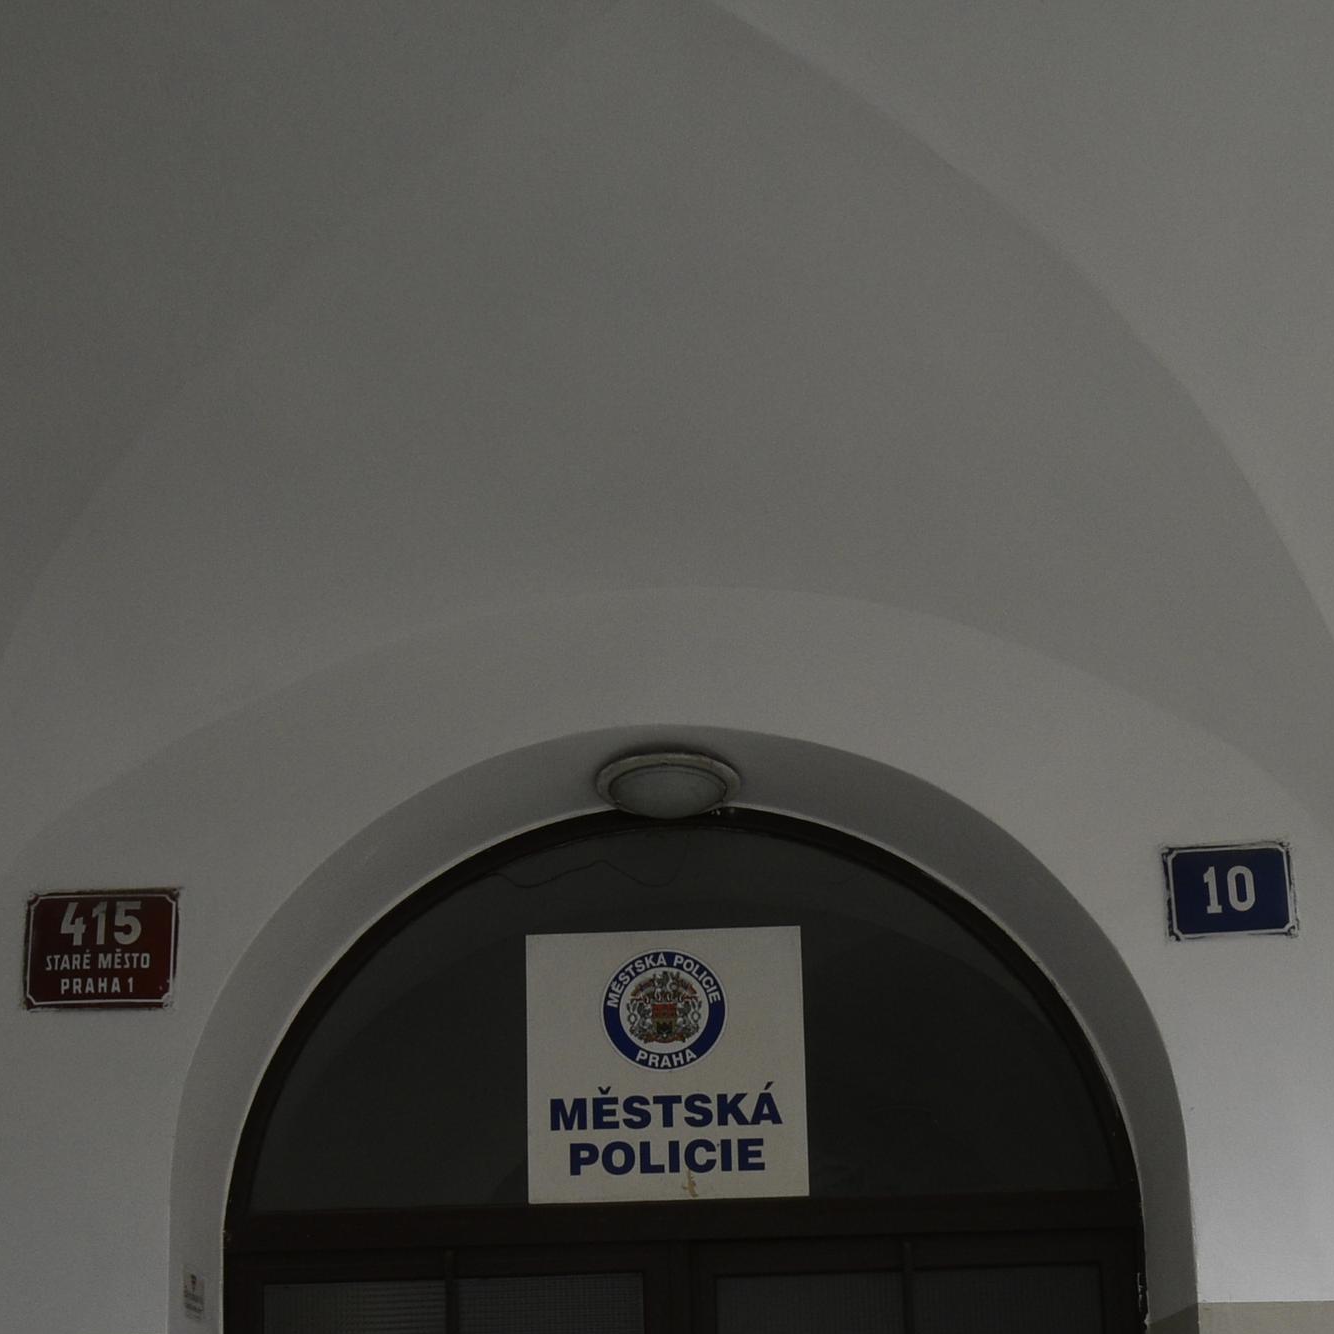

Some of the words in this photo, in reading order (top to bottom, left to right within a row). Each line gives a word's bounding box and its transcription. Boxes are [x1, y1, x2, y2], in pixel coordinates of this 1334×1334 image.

[1203, 865, 1256, 914] 10
[60, 901, 142, 946] 415
[45, 949, 92, 971] STARÉ
[98, 948, 151, 970] MĚSTO
[60, 977, 121, 995] PRAHA
[127, 976, 134, 993] 1
[607, 952, 668, 1009] MĚSTSKÁ
[673, 954, 722, 1004] POLICIE
[635, 1049, 698, 1069] PRAHA
[550, 1081, 783, 1132] MĚSTSKÁ
[569, 1138, 766, 1176] POLICIE
